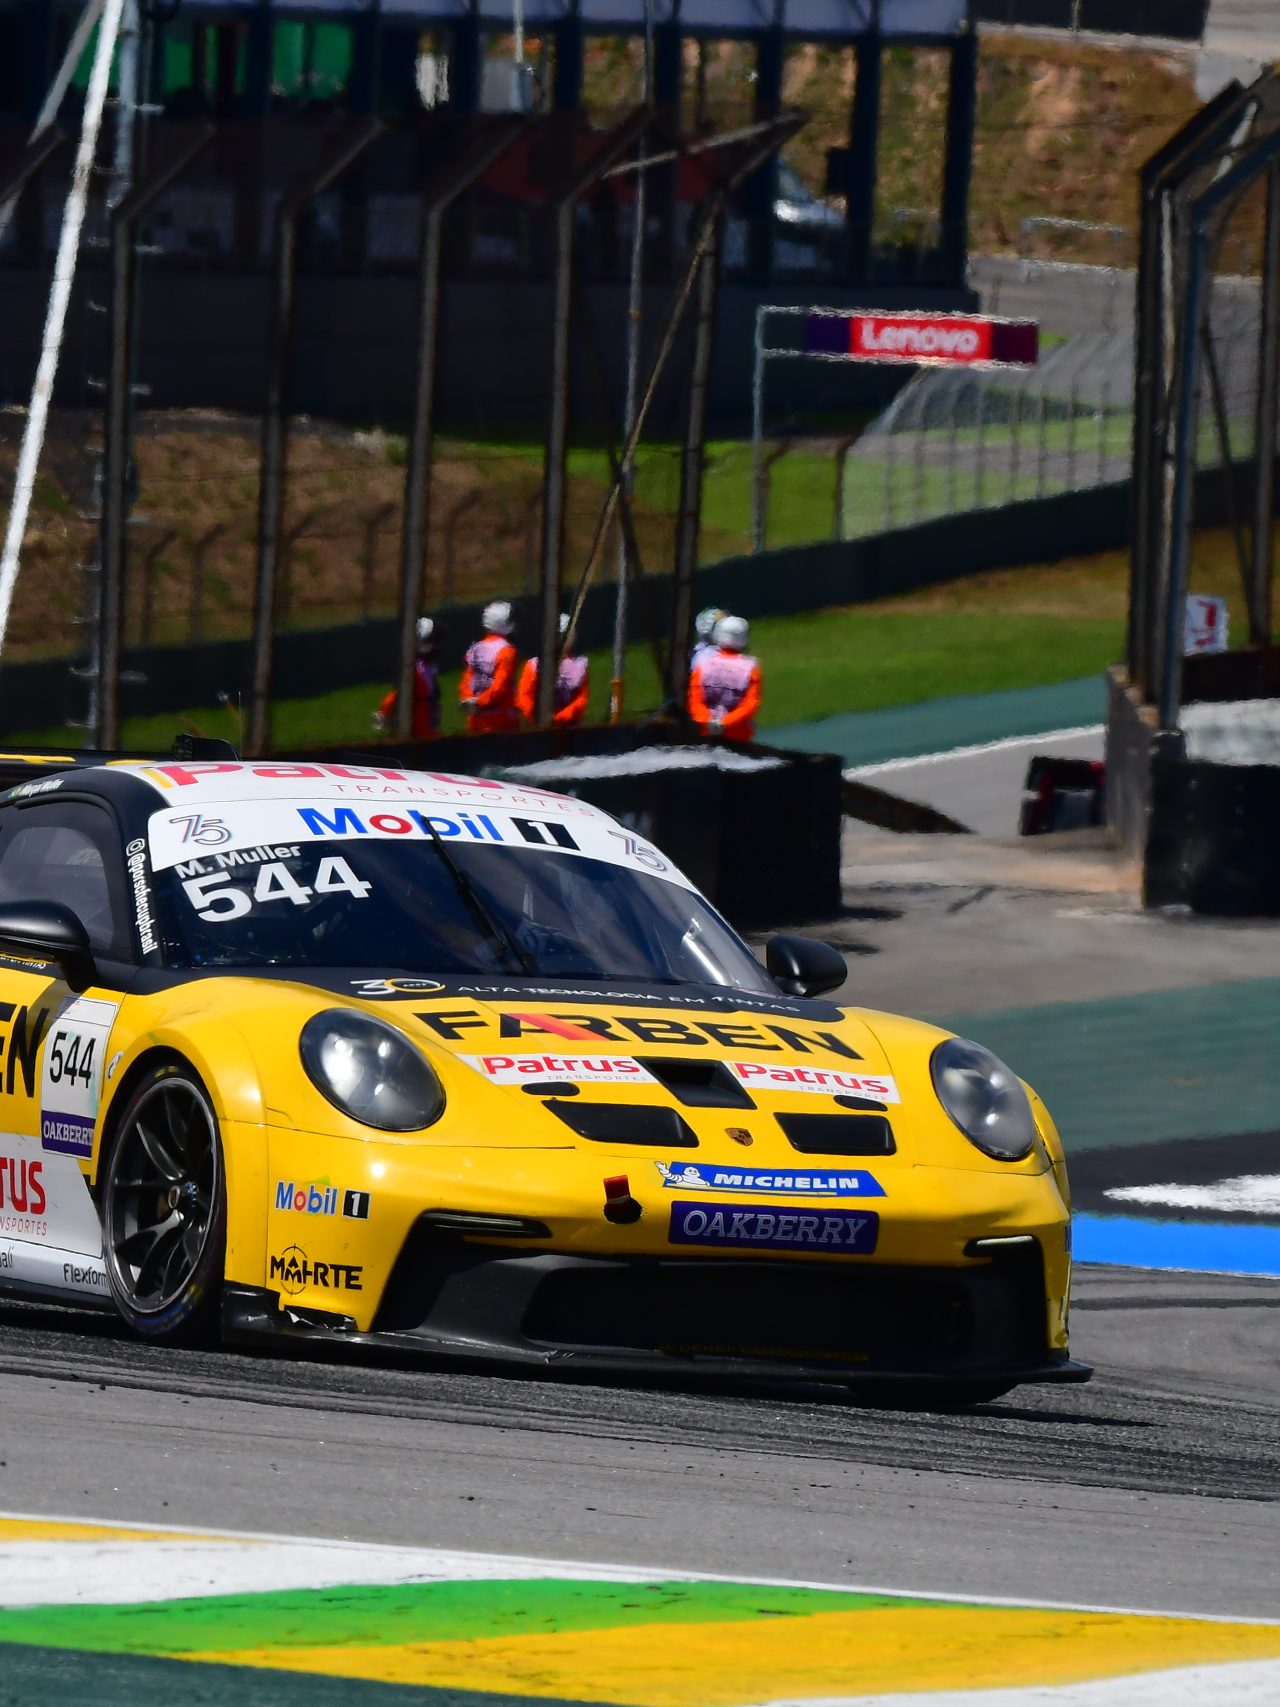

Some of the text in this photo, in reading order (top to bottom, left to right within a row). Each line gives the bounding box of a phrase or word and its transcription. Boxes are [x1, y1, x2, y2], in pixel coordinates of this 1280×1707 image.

[861, 320, 980, 354] Lenovo
[331, 784, 595, 817] TRANSPORTES
[296, 807, 507, 843] Mobil
[174, 845, 301, 879] M. Muller
[181, 855, 372, 923] 544
[458, 985, 520, 994] ALTA
[412, 1010, 865, 1060] FARBEN
[49, 1030, 96, 1089] 544
[483, 1056, 641, 1076] Patrus
[734, 1062, 889, 1094] Patrus
[42, 1120, 94, 1147] OAKBERRY
[275, 1181, 338, 1215] Mobil
[713, 1172, 860, 1190] MICHELIN
[682, 1209, 868, 1245] OAKBERRY
